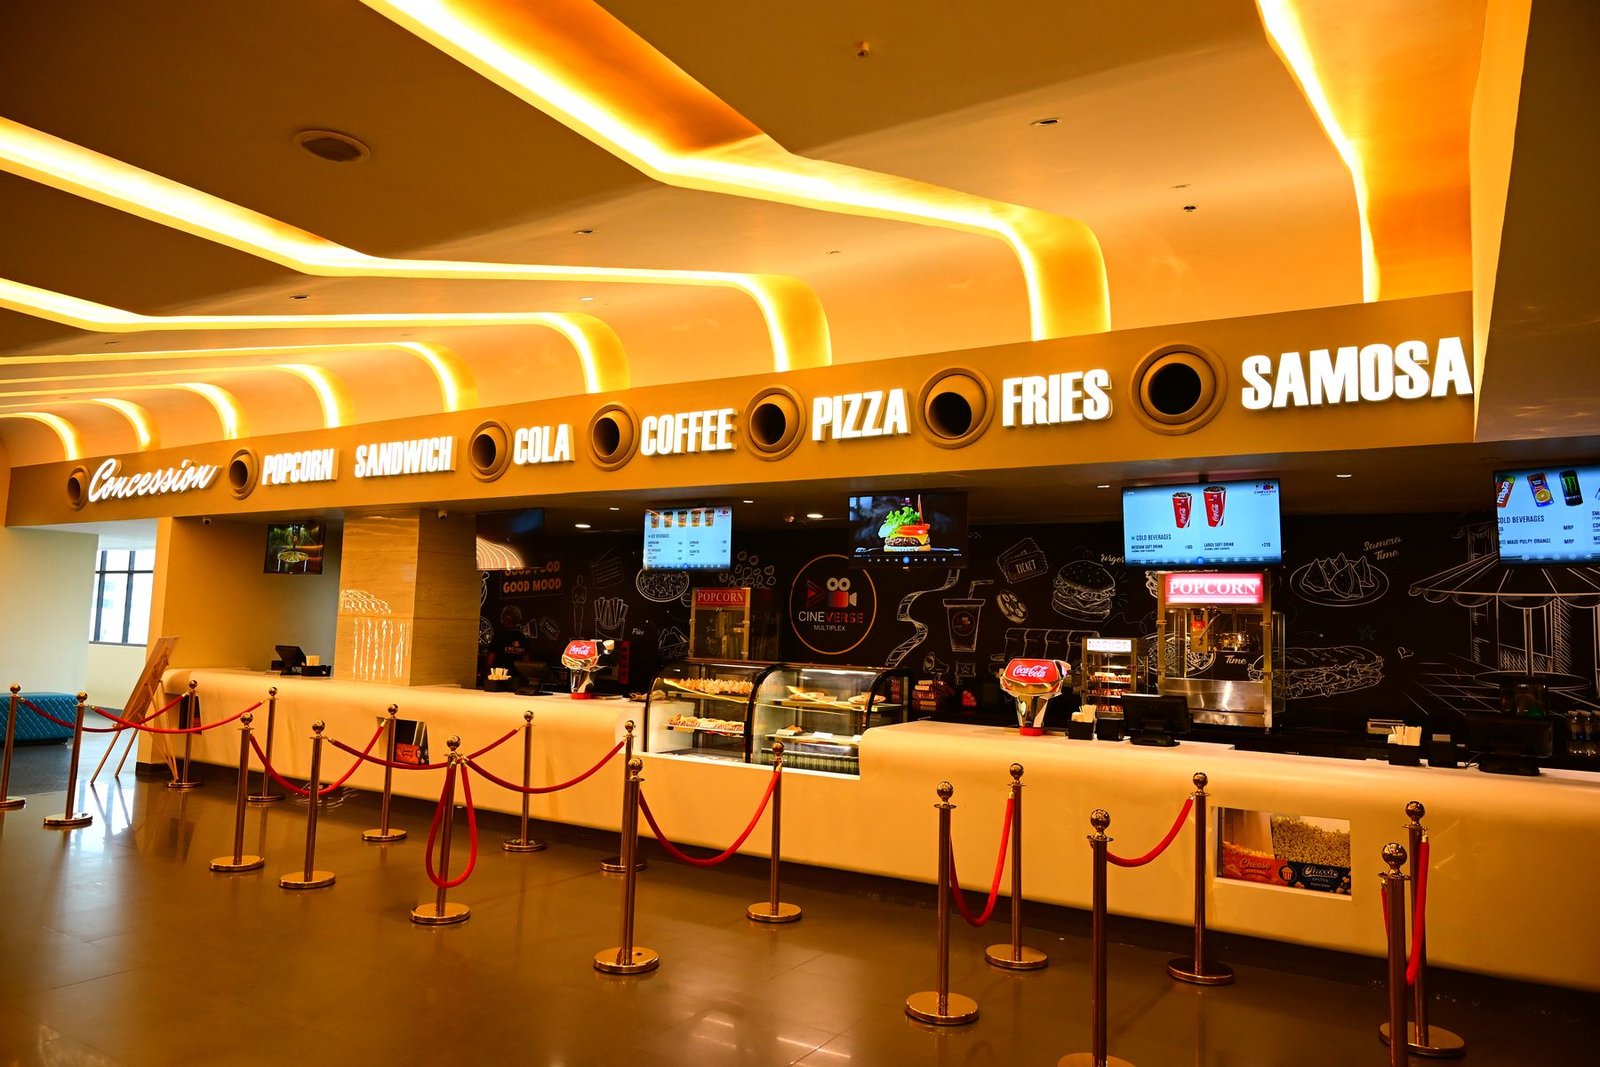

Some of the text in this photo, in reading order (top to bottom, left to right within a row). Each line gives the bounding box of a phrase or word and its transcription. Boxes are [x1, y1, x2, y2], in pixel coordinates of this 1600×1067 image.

[1241, 336, 1473, 410] SAMOSA
[1002, 368, 1112, 427] FRIES
[812, 388, 909, 442] PIZZA
[640, 408, 737, 457] COFFEE
[513, 424, 573, 466] COLA
[354, 436, 454, 479] SANDWICH
[262, 448, 336, 486] POPCORN
[88, 458, 219, 503] Concession
[1512, 515, 1544, 523] BEVERAGES
[1363, 537, 1404, 551] Samosa
[1374, 549, 1401, 561] Time
[1014, 559, 1038, 574] TICKET
[503, 578, 562, 594] GOOD MOOD
[1168, 582, 1257, 595] POPCORN
[697, 592, 745, 603] POPCORN
[798, 611, 864, 624] CINEVERSE
[813, 624, 846, 632] MULTIPLEX
[1224, 655, 1247, 665] Time
[1012, 664, 1049, 678] Coca-Cola
[1239, 858, 1271, 869] Cheese
